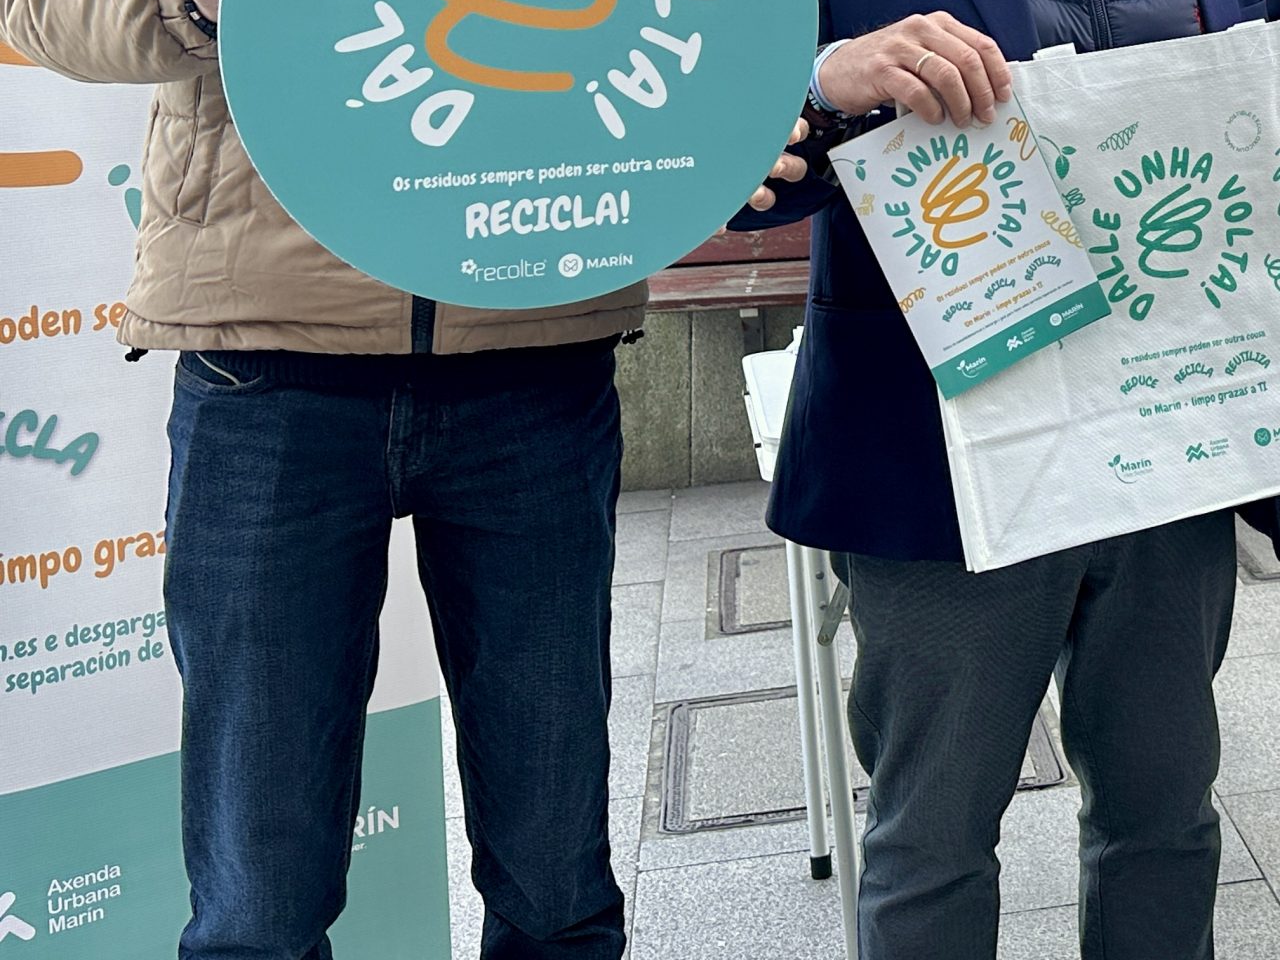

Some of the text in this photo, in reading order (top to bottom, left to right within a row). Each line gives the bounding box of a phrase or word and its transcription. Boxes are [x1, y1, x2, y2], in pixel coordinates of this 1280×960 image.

[393, 156, 694, 192] Os residuos sempre poden ser outra cousa
[465, 190, 630, 239] RECICLA!
[885, 134, 1026, 276] DÁLLE UNHA VOLTA!
[1114, 147, 1212, 198] UNHA
[1200, 174, 1253, 309] VOLTA!
[475, 259, 546, 283] recolte
[587, 253, 633, 269] MARÍN
[942, 300, 974, 322] REDUCE
[984, 277, 1016, 300] RECICLA
[1025, 255, 1062, 281] REUTILIZA
[1121, 330, 1266, 365] Os residuos sempre poden ser outra cousa
[1120, 350, 1271, 395] REDUCE RECICLA REUTILIZA
[1139, 407, 1152, 417] Un
[1192, 394, 1215, 407] limpo
[1218, 386, 1248, 404] grazas
[1251, 385, 1256, 394] a
[1257, 381, 1268, 392] TI
[45, 634, 58, 651] e
[6, 639, 164, 695] separación de
[47, 864, 121, 896] Axenda
[48, 884, 121, 914] Urbana
